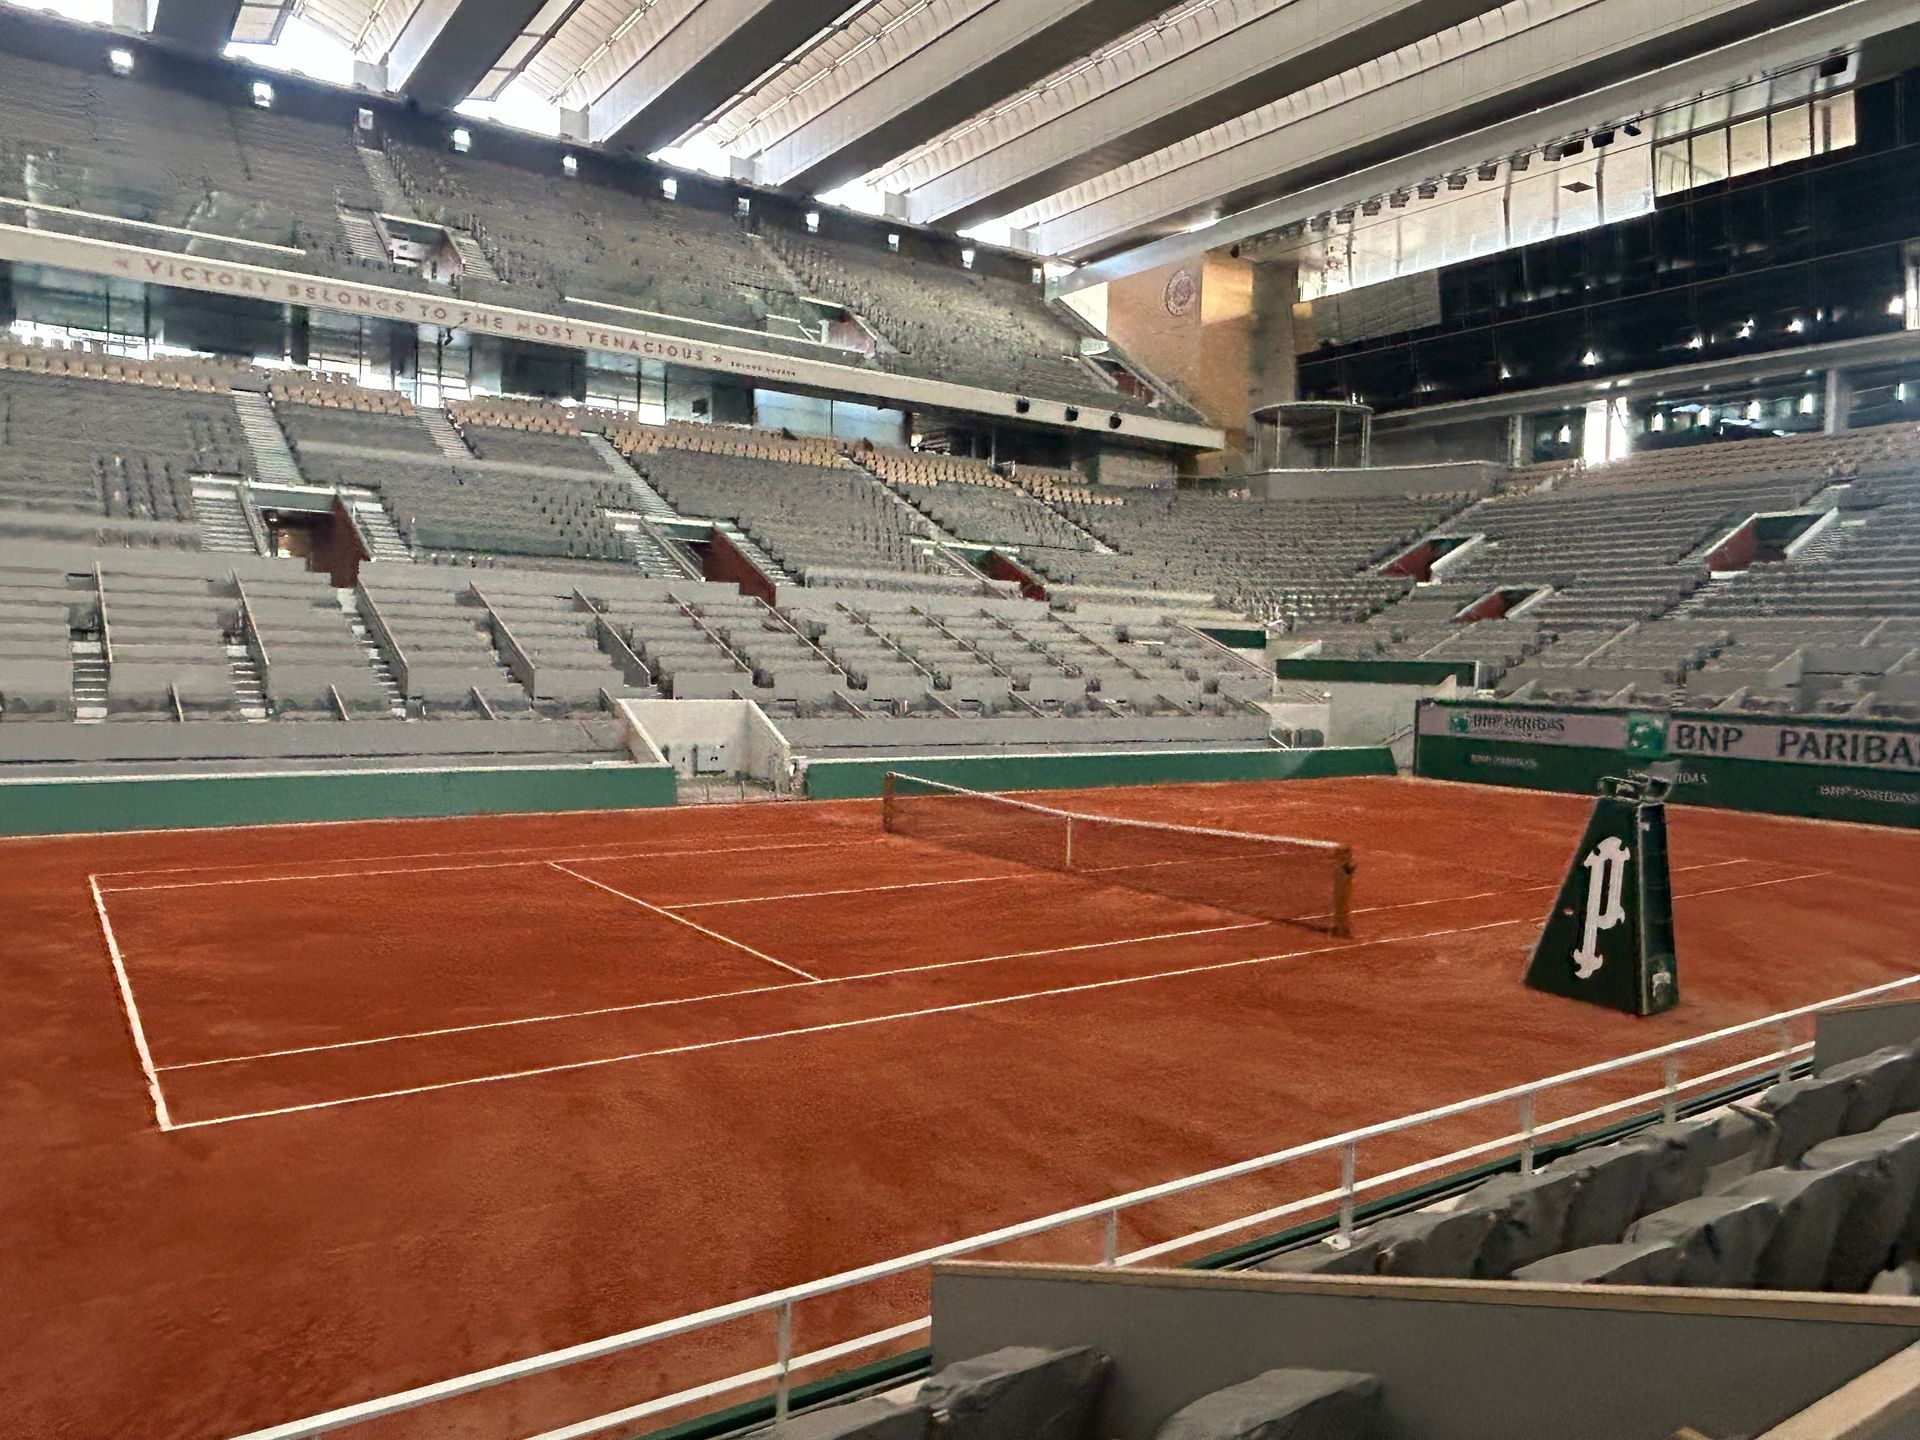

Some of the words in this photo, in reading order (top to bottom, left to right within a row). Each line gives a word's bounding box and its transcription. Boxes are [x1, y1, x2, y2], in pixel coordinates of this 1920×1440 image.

[143, 257, 272, 293] VICTORY
[286, 282, 406, 313] BELONGS
[419, 304, 447, 320] TO
[461, 311, 503, 330] THE
[516, 320, 575, 341] MOST
[586, 330, 704, 362] TENACIOUS
[1676, 723, 1744, 752] BNP
[1777, 728, 1920, 768] PARIBA
